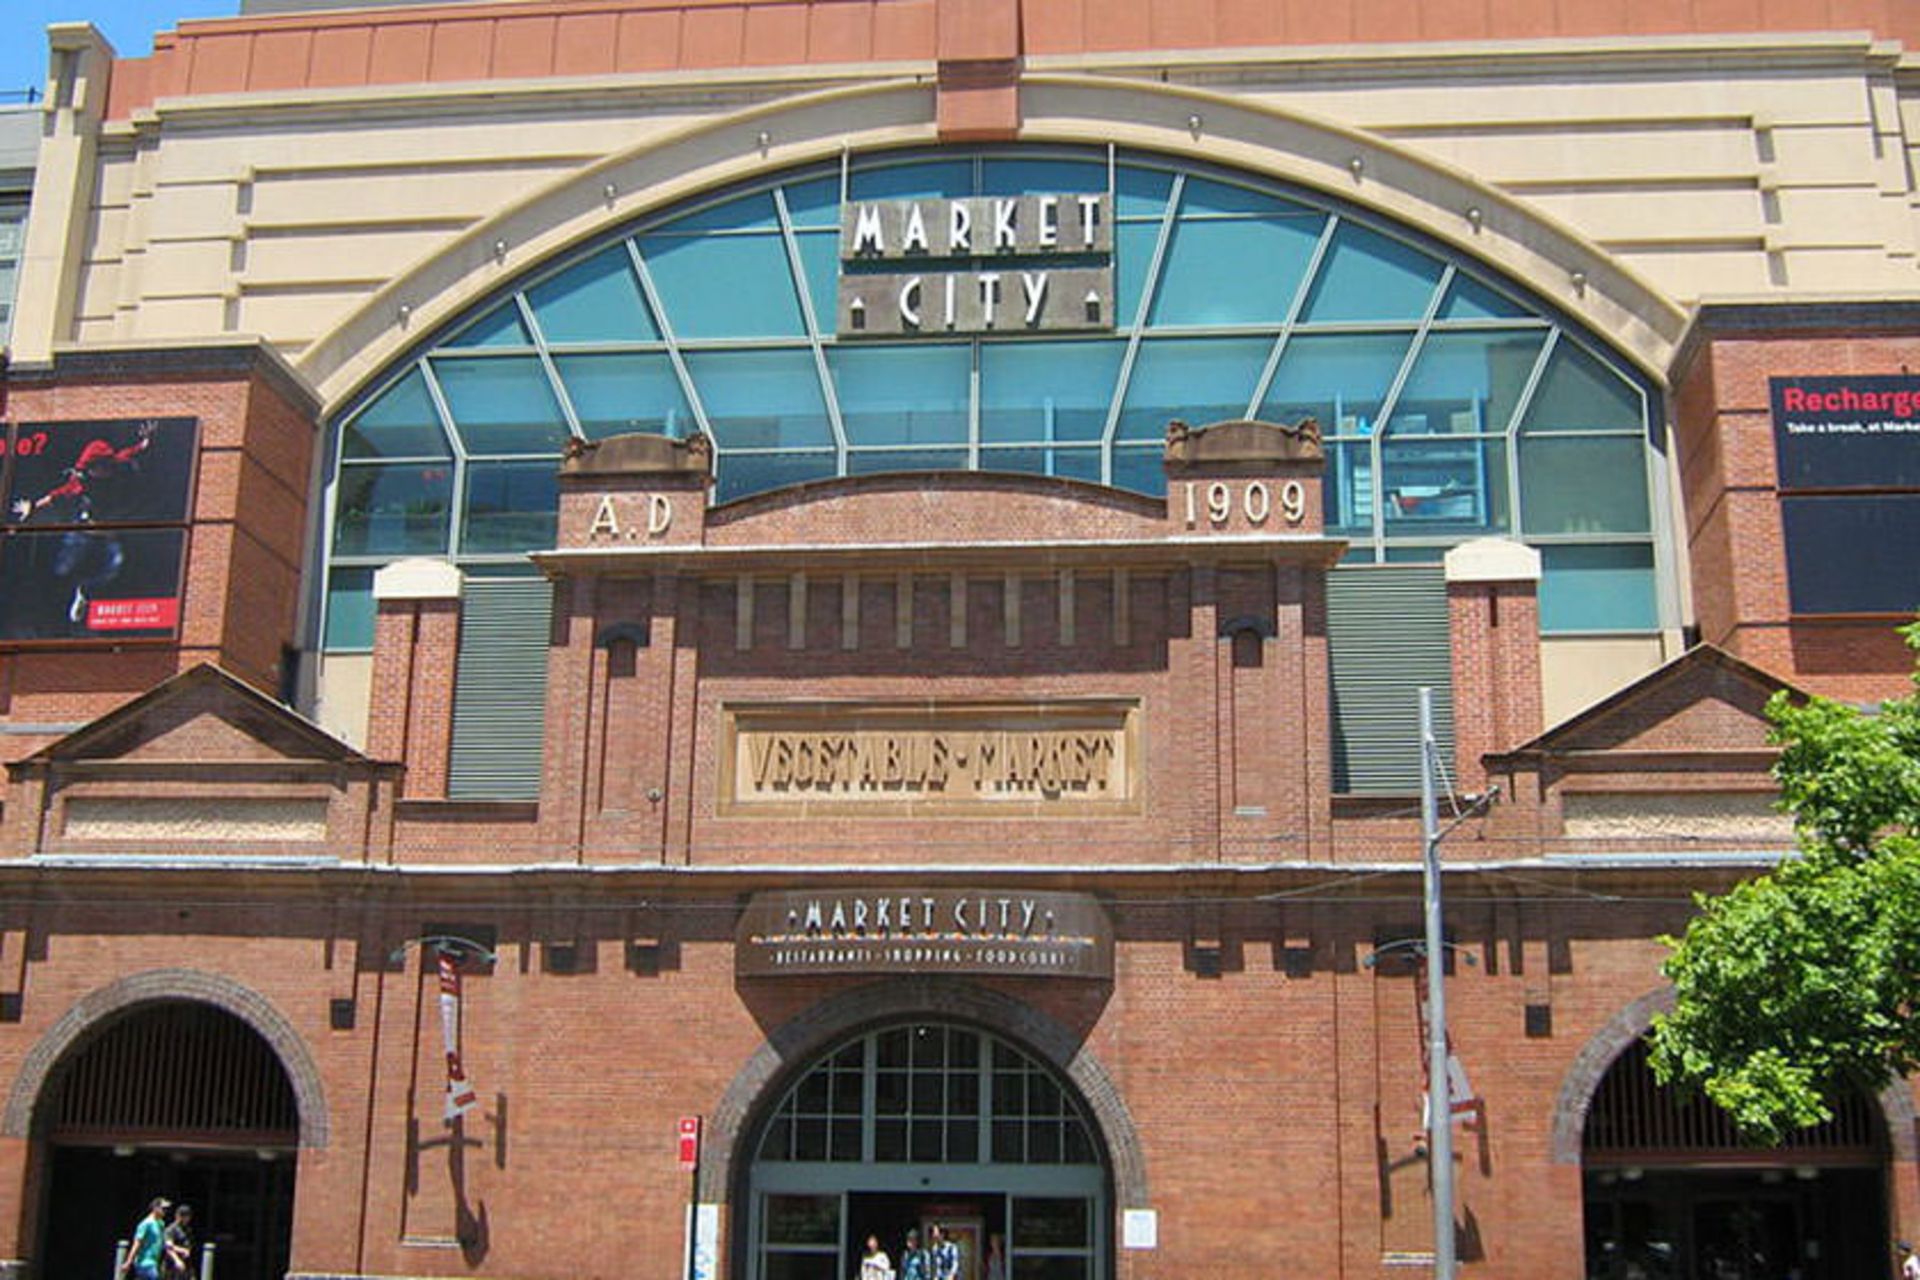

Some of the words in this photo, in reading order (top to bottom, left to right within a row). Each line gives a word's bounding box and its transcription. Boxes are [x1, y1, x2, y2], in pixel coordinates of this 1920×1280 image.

[853, 197, 1100, 250] MARKET
[900, 272, 1048, 325] CITY
[1185, 480, 1305, 523] 1909
[752, 734, 950, 788] VEGETABLE
[973, 734, 1116, 790] MARKET
[805, 898, 934, 928] MARKET
[954, 898, 1035, 928] CITY
[885, 949, 961, 963] SHOPPING
